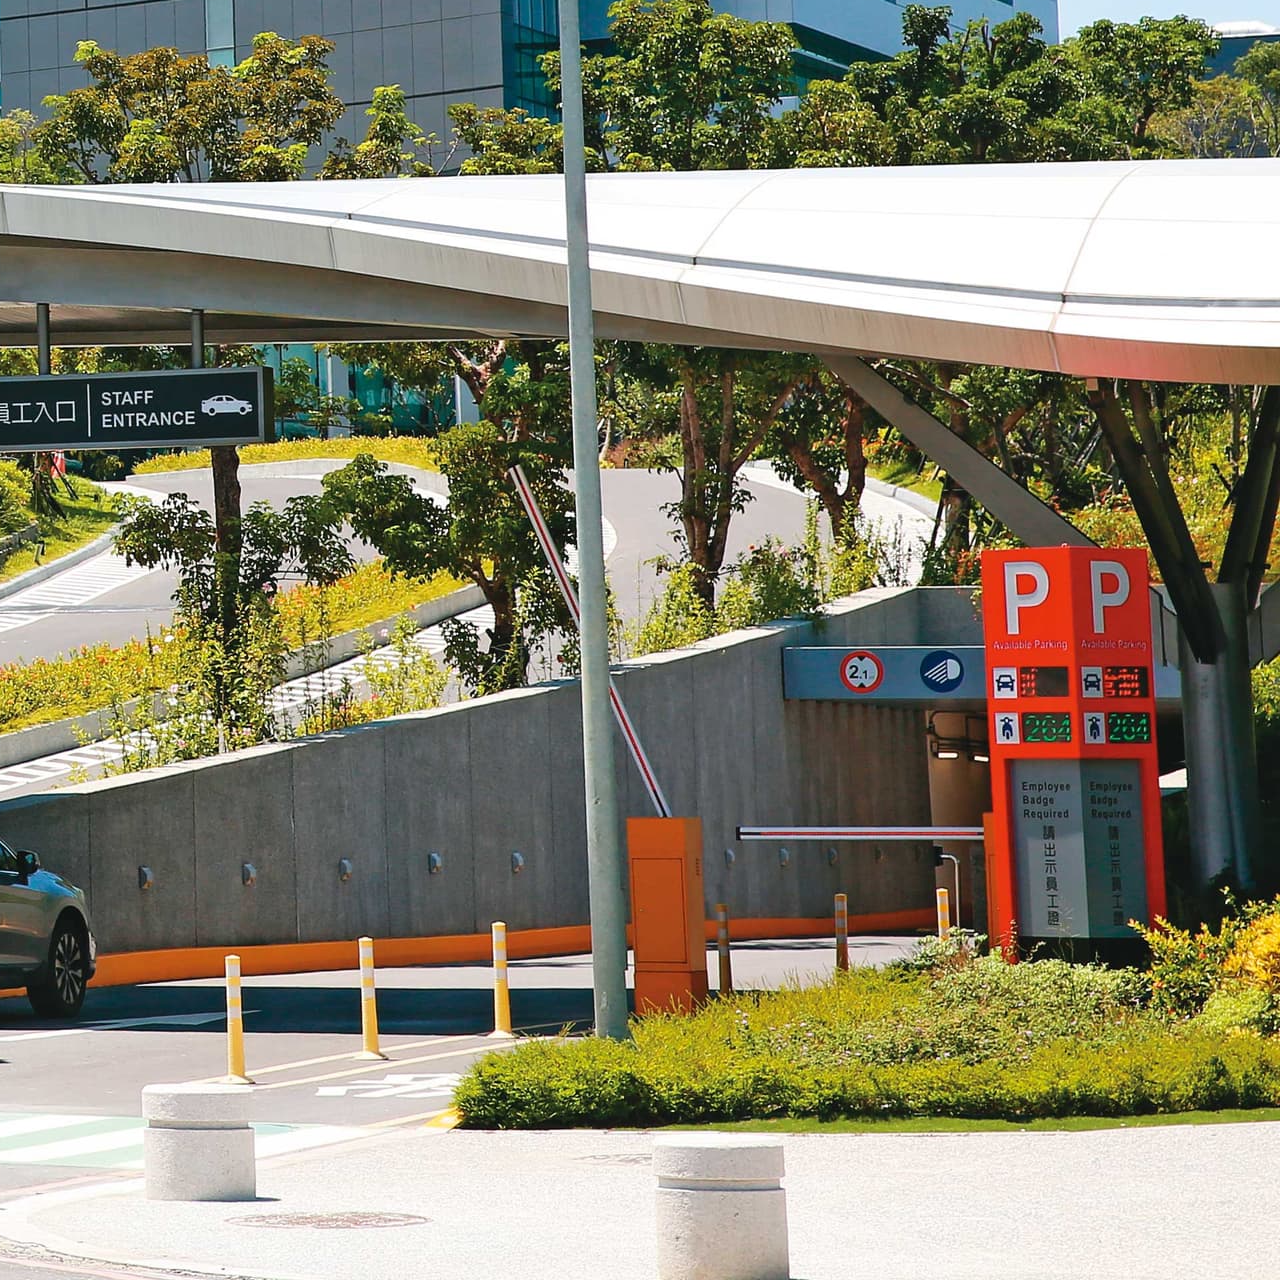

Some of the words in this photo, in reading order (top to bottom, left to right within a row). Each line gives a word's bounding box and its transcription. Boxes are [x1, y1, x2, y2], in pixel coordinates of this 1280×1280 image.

[101, 390, 154, 406] STAFF
[102, 410, 196, 428] ENTRANCE
[1003, 561, 1050, 635] P
[1090, 560, 1131, 634] P
[993, 640, 1032, 650] Available
[1034, 639, 1068, 651] Parking
[1081, 639, 1116, 649] Available
[1118, 639, 1147, 650] Parking
[1021, 781, 1071, 792] Employee
[1089, 781, 1133, 792] Employee
[1022, 795, 1055, 806] Badge
[1090, 795, 1118, 806] Badge
[1023, 809, 1069, 820] Required
[1091, 809, 1132, 820] Required
